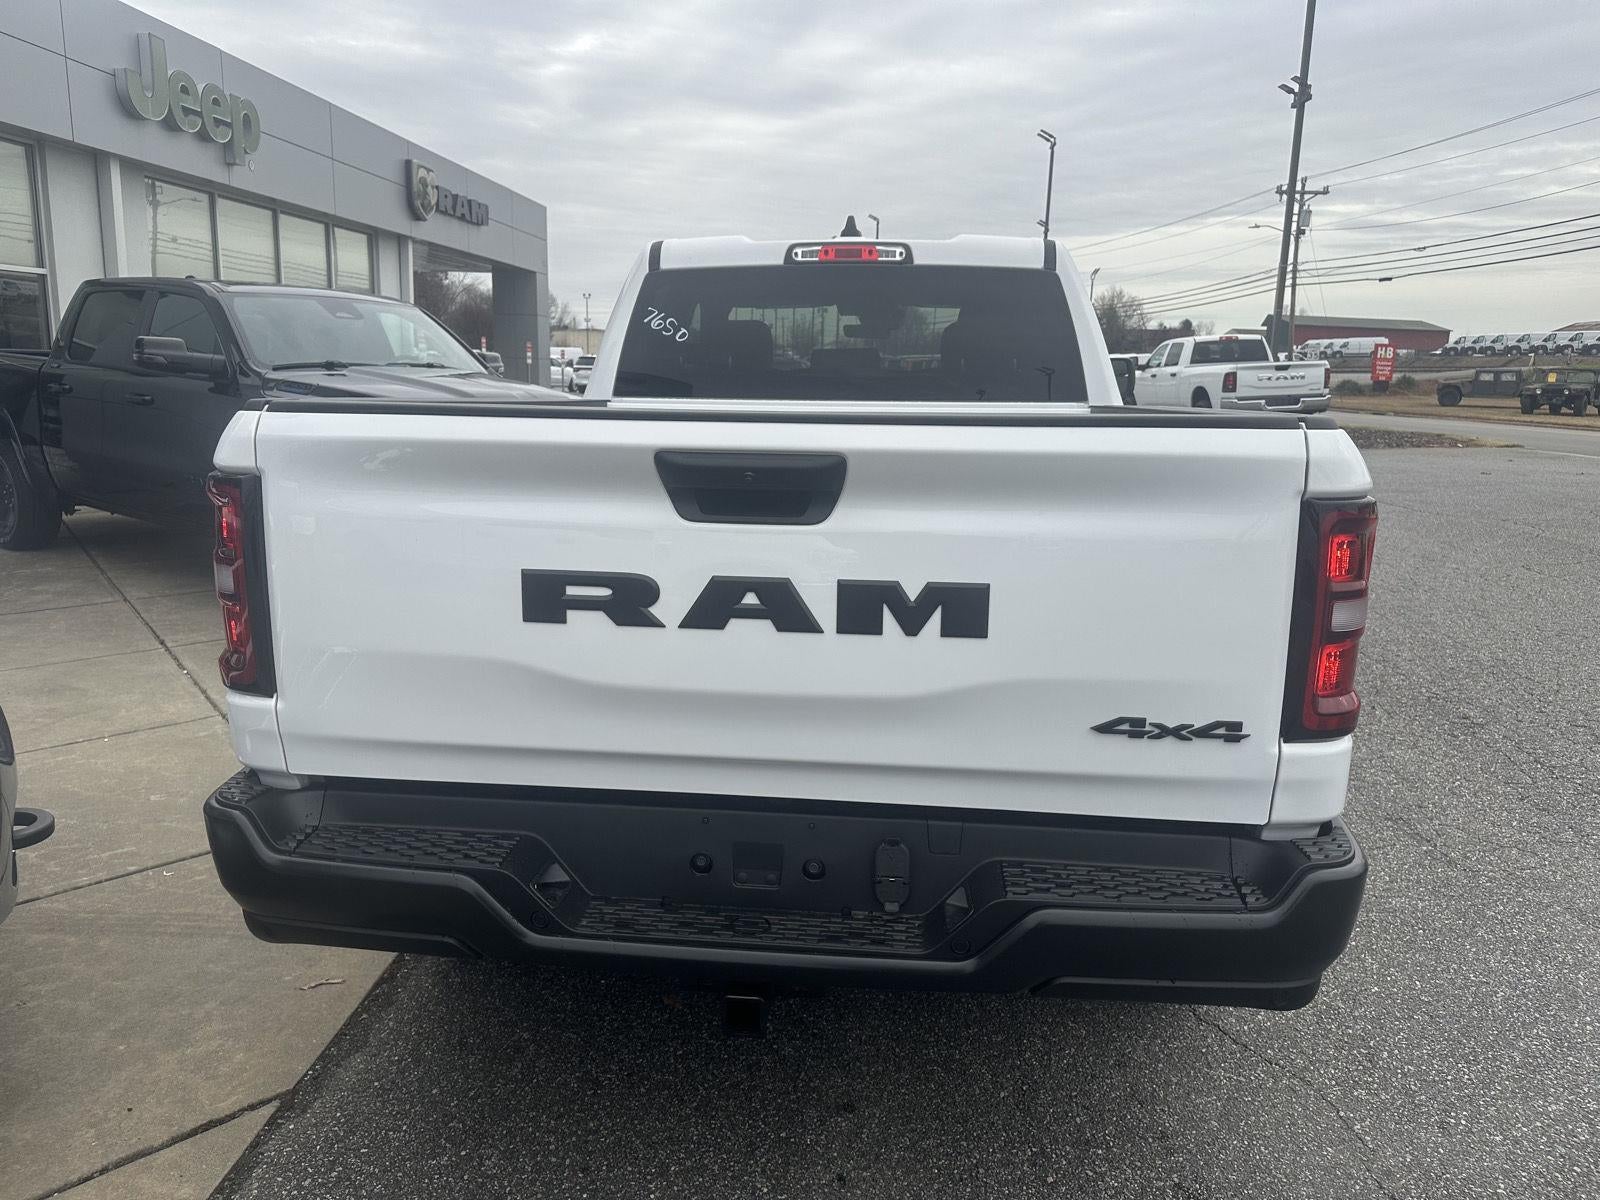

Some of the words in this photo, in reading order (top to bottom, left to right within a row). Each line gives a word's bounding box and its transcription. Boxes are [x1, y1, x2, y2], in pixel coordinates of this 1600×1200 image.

[114, 32, 260, 166] Jeep
[436, 185, 489, 226] RAM
[643, 306, 689, 342] 7650
[1257, 372, 1306, 381] RAM
[521, 568, 991, 639] RAM
[1089, 716, 1252, 743] 4x4
